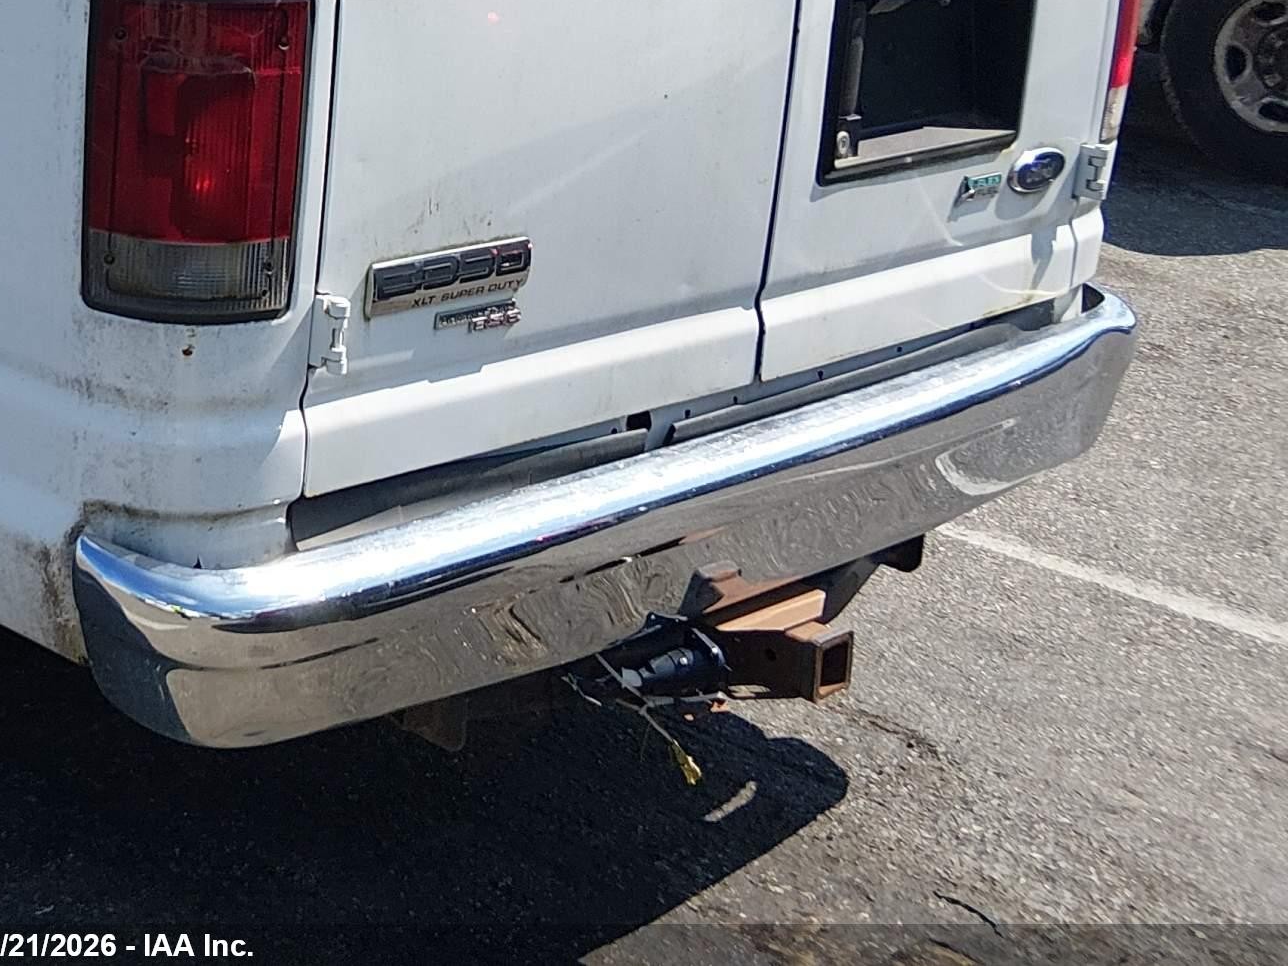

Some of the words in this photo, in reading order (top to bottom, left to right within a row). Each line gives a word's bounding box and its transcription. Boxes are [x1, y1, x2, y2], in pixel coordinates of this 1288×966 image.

[412, 295, 436, 308] XLT
[441, 286, 484, 303] SUPER
[488, 278, 524, 293] DUTY
